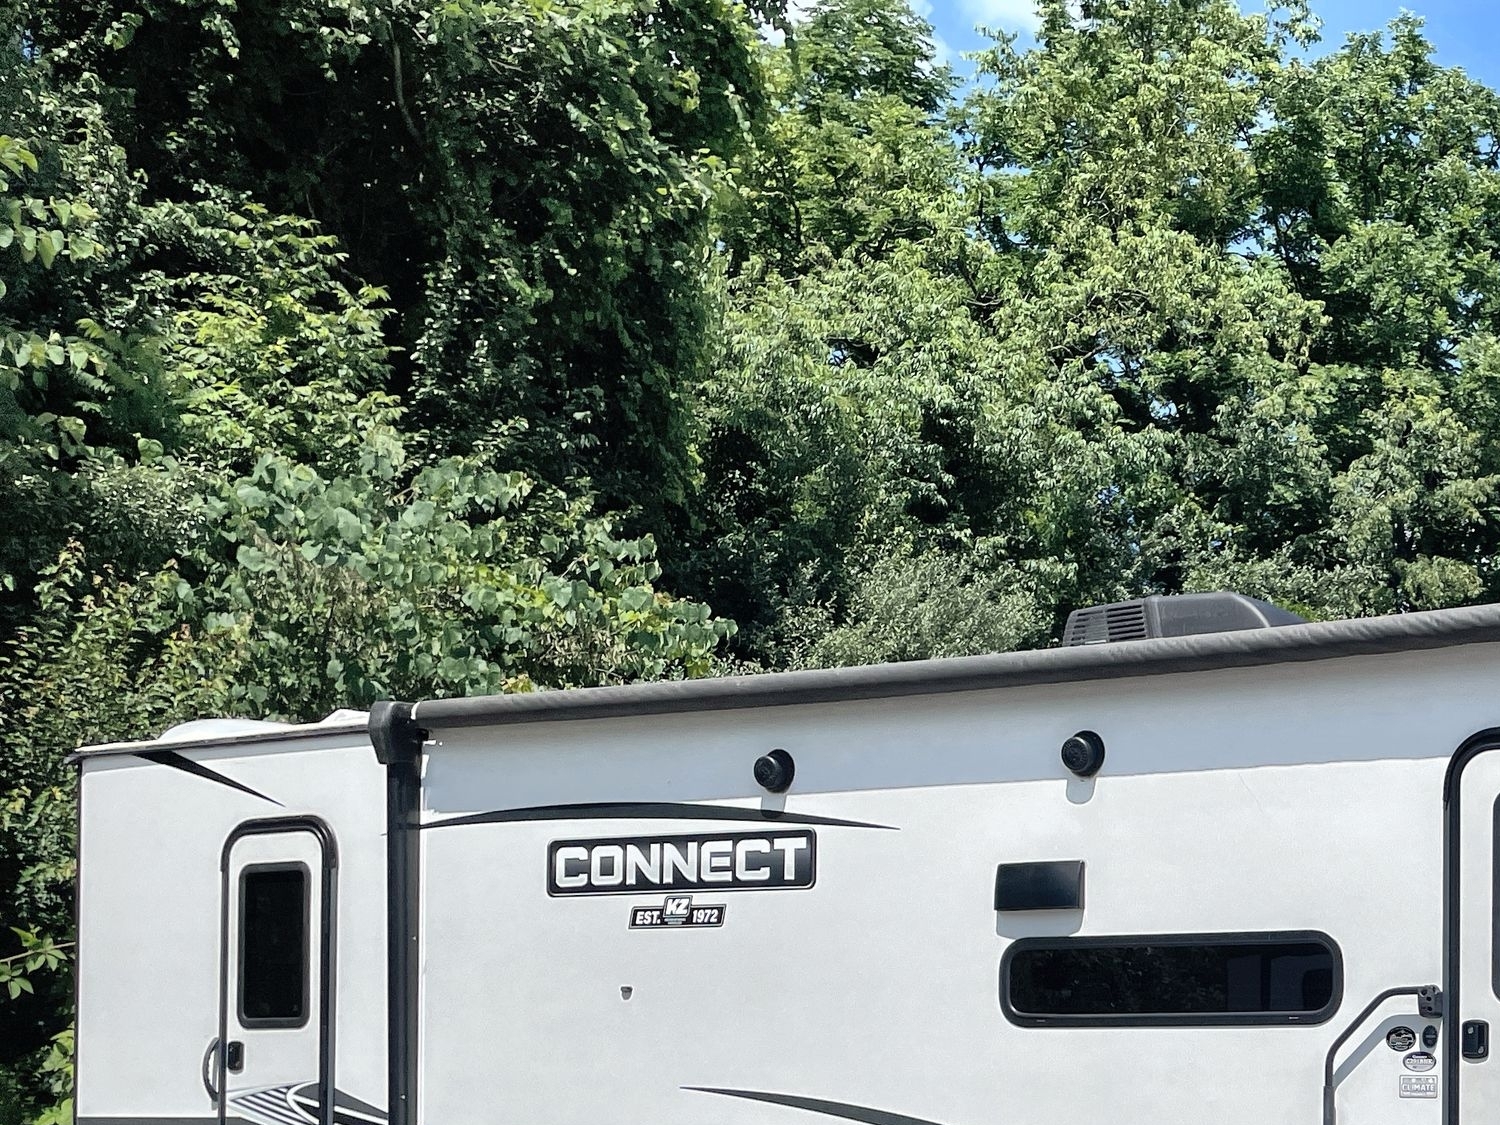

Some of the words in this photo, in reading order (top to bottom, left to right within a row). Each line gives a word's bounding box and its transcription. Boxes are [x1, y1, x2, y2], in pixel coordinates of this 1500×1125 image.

[555, 837, 806, 887] CONNECT
[635, 911, 661, 925] EST.
[665, 898, 689, 915] KZ
[692, 909, 719, 923] 1972
[1402, 1083, 1436, 1092] CLIMATE
